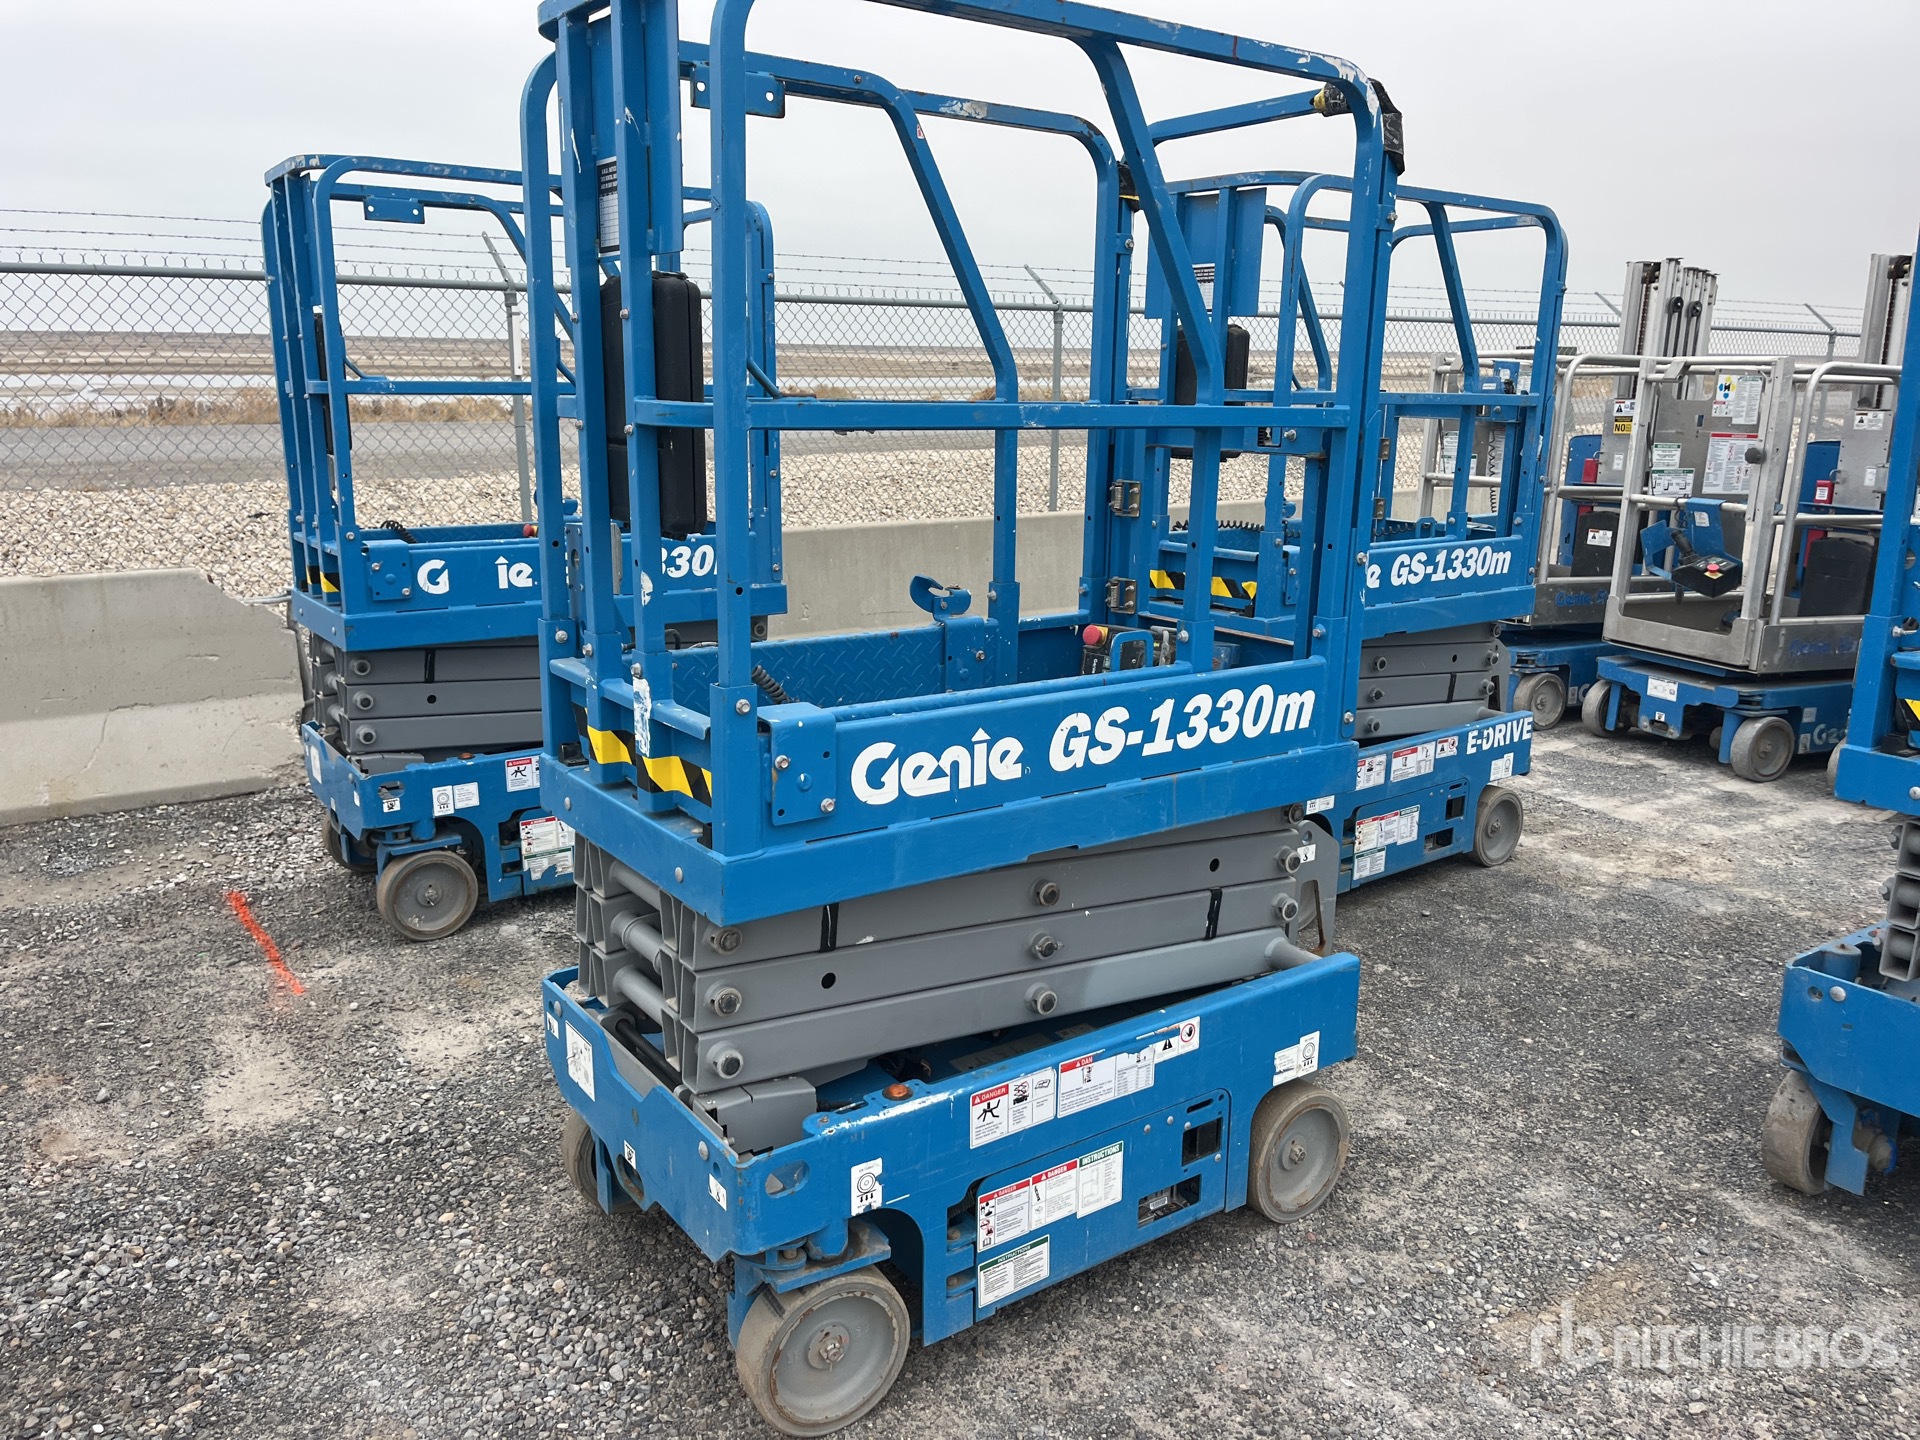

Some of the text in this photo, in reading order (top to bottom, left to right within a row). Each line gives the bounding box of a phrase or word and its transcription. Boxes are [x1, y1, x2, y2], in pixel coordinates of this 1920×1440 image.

[1391, 545, 1511, 586] GS-1330m
[850, 684, 1316, 806] Genie GS-1330m
[1466, 716, 1533, 755] E-DRIVE
[981, 1087, 1006, 1101] DANGER
[1082, 1144, 1120, 1166] INSTRUCTIONS
[1047, 1165, 1068, 1178] DANGER
